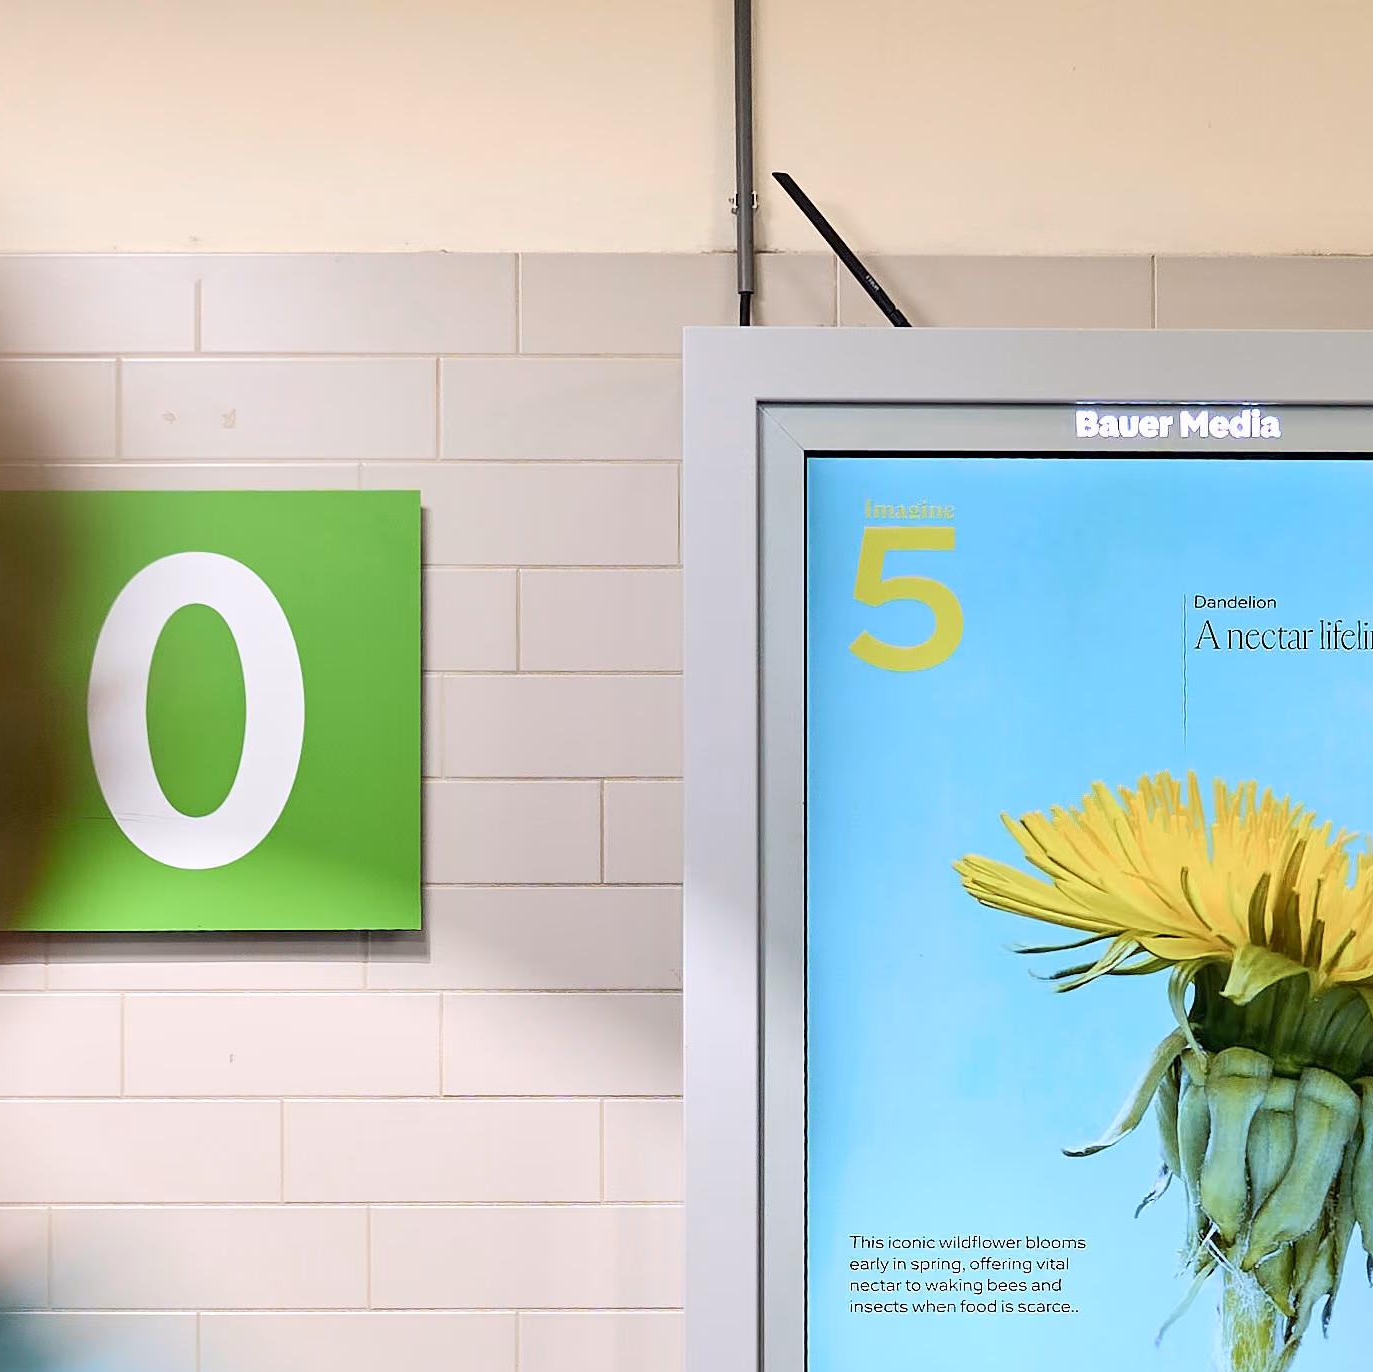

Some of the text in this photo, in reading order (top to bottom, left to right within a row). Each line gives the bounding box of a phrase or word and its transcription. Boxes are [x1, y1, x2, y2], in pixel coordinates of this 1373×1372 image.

[1075, 408, 1282, 438] Bauer Media
[864, 498, 956, 520] Imagine
[848, 526, 965, 673] 5
[1194, 595, 1277, 609] Dandelion
[1194, 619, 1221, 650] A
[1226, 627, 1314, 651] nectar
[86, 550, 306, 870] 0
[849, 1235, 1087, 1249] This iconic wildflower blooms
[849, 1257, 1070, 1274] early in spring, offering vital
[850, 1278, 1062, 1295] nectar to waking bees and
[850, 1300, 908, 1314] insects
[912, 1300, 957, 1314] when
[960, 1300, 997, 1314] food
[1001, 1300, 1014, 1314] is
